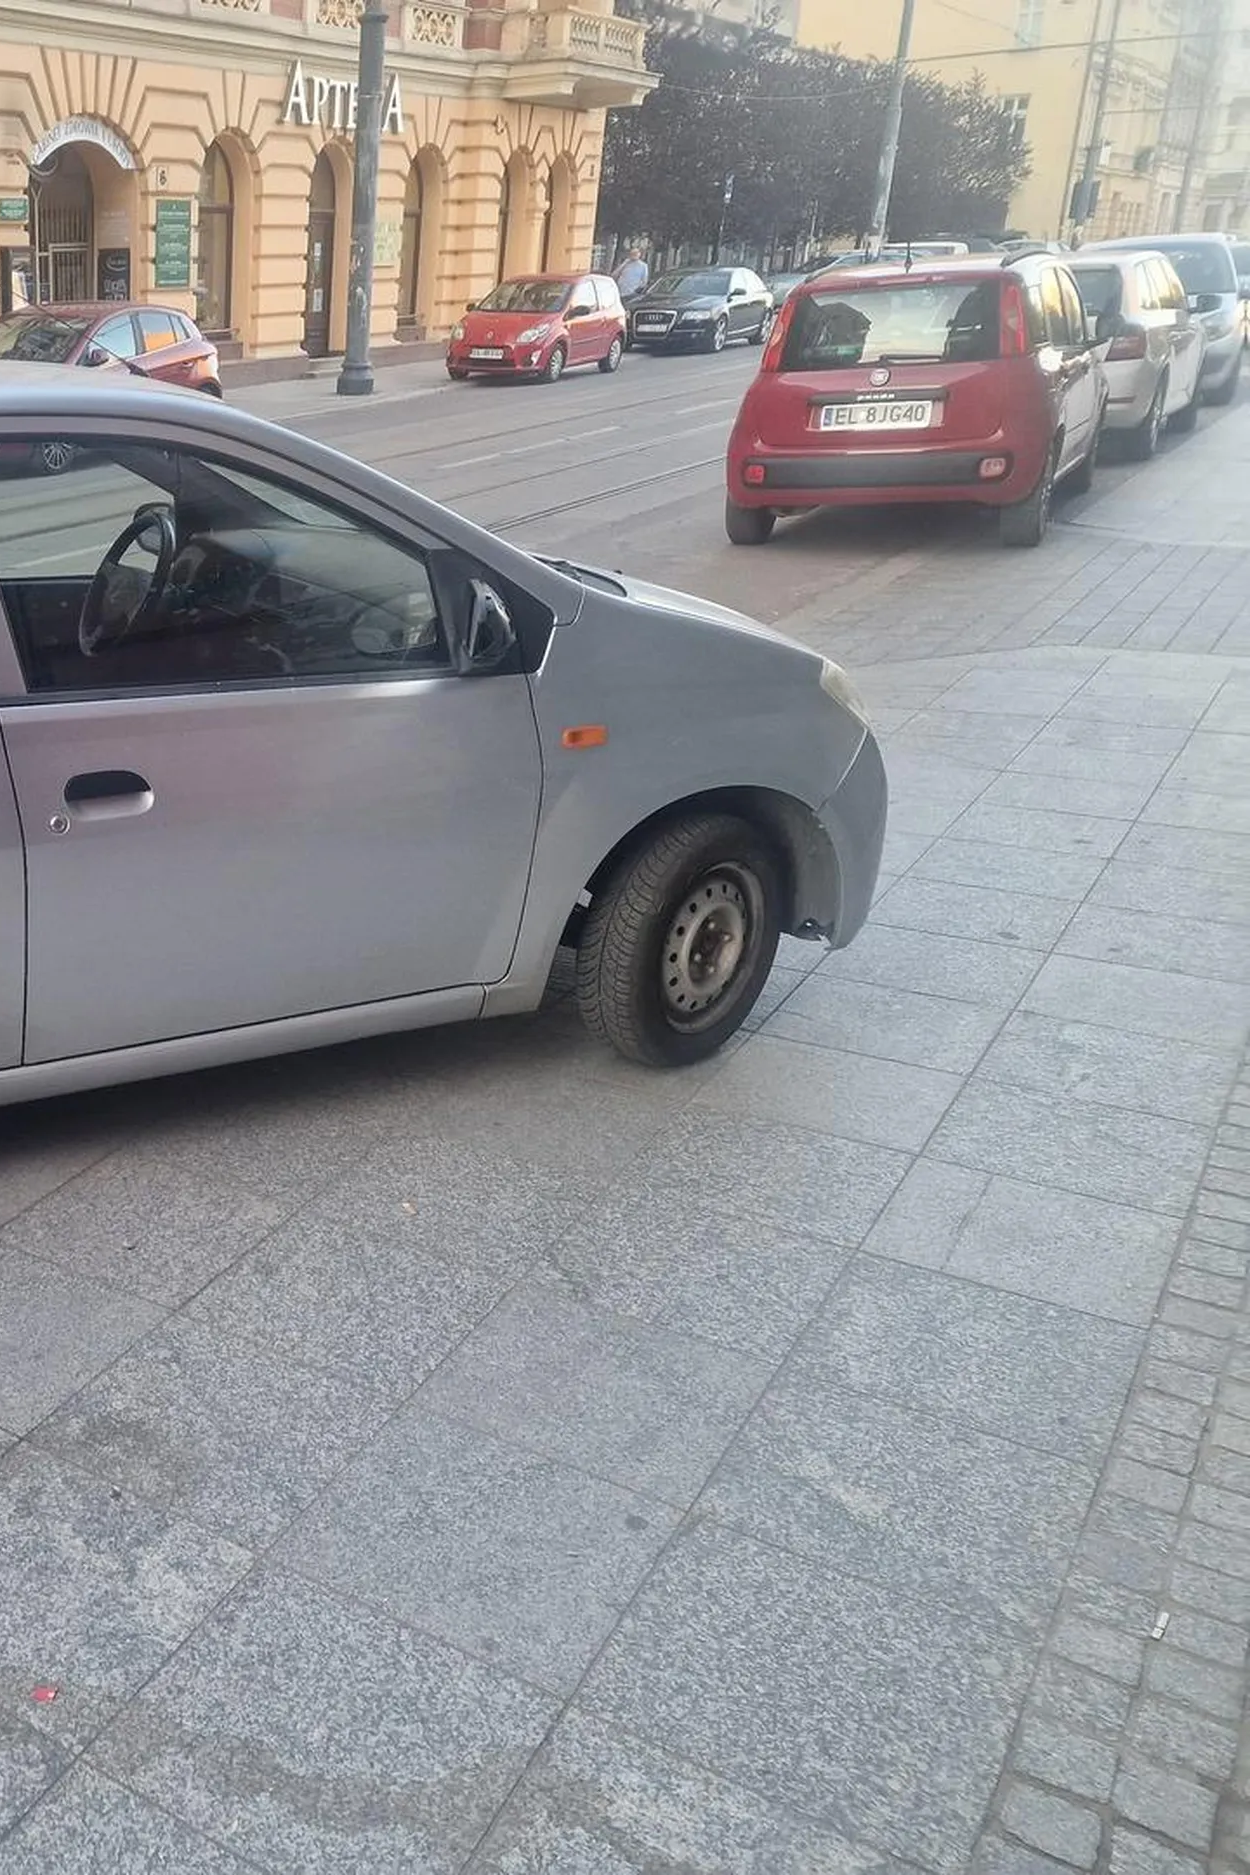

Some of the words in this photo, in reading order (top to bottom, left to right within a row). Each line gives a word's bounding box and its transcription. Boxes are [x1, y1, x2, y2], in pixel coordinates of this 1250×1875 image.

[284, 59, 405, 133] APTEA
[834, 407, 858, 426] EL
[865, 404, 926, 423] 8JG40
